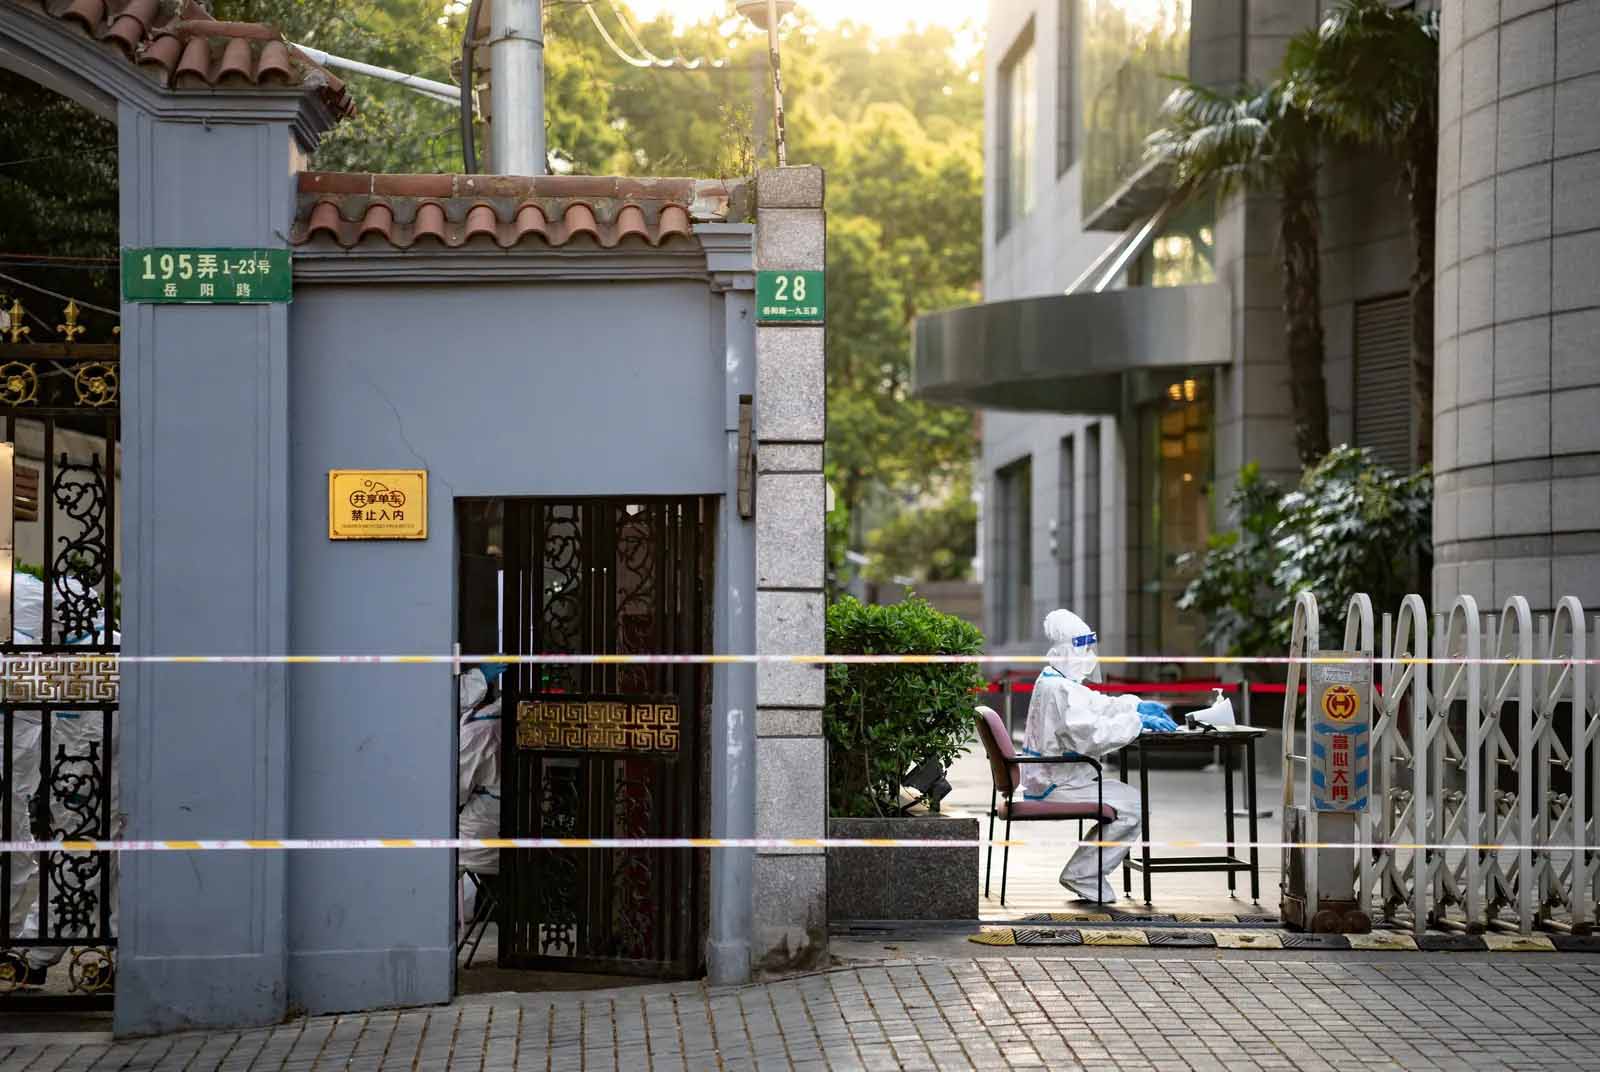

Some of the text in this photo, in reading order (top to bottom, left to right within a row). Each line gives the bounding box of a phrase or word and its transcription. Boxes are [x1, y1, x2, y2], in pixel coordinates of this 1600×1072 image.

[142, 254, 218, 280] 195弄
[163, 283, 251, 298] 岳阳路
[775, 275, 806, 301] 28
[353, 494, 402, 505] 共享单车
[351, 510, 404, 521] 禁止入内
